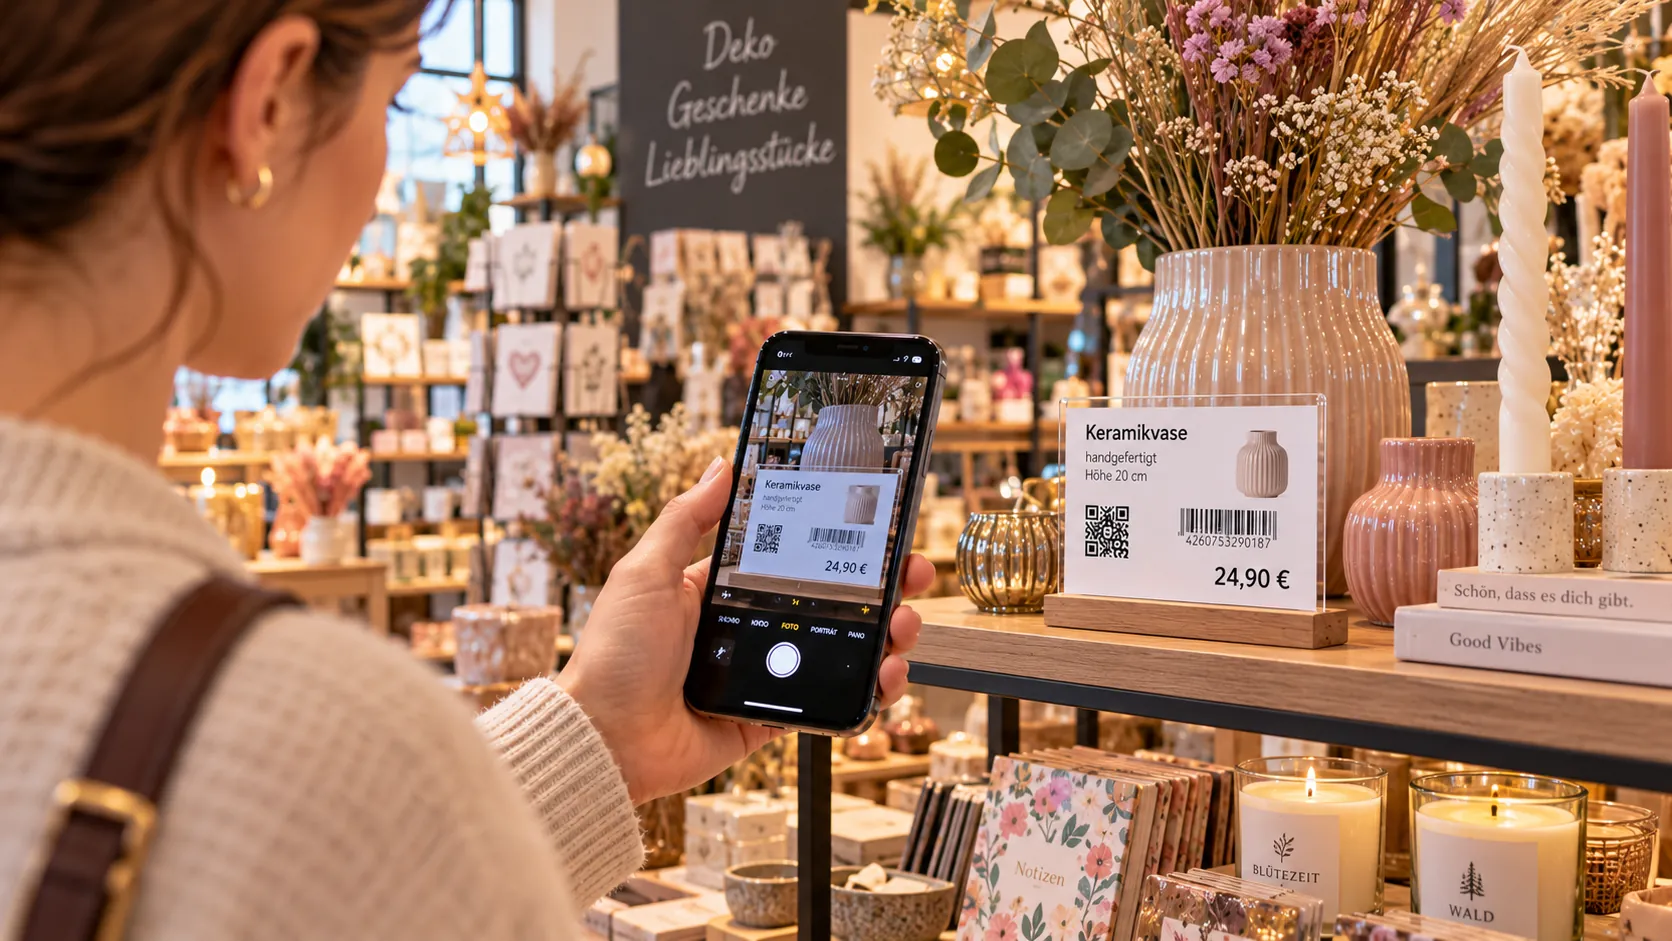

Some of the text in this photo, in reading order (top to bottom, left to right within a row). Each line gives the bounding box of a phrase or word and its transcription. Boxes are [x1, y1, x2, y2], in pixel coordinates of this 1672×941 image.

[703, 17, 777, 70] Deko
[667, 69, 808, 130] Geschenke
[645, 121, 836, 194] Lieblingsstücke
[1085, 423, 1188, 442] Keramikvase
[1085, 451, 1157, 466] handgefertigt
[1085, 469, 1148, 482] Höhe 20 cm
[765, 479, 821, 492] Keramikvase
[1185, 534, 1271, 549] 4260753290187
[825, 560, 868, 576] 24,90 €
[1214, 566, 1290, 590] 24,90 €
[1454, 583, 1634, 610] Schön, dass es dich gibt.
[781, 622, 800, 631] FOTO
[848, 631, 865, 640] PANO
[1450, 632, 1543, 654] Good Vibes
[1014, 860, 1065, 887] Notizen
[1253, 864, 1320, 883] BLÜTEZEIT
[1449, 904, 1494, 923] WALD
